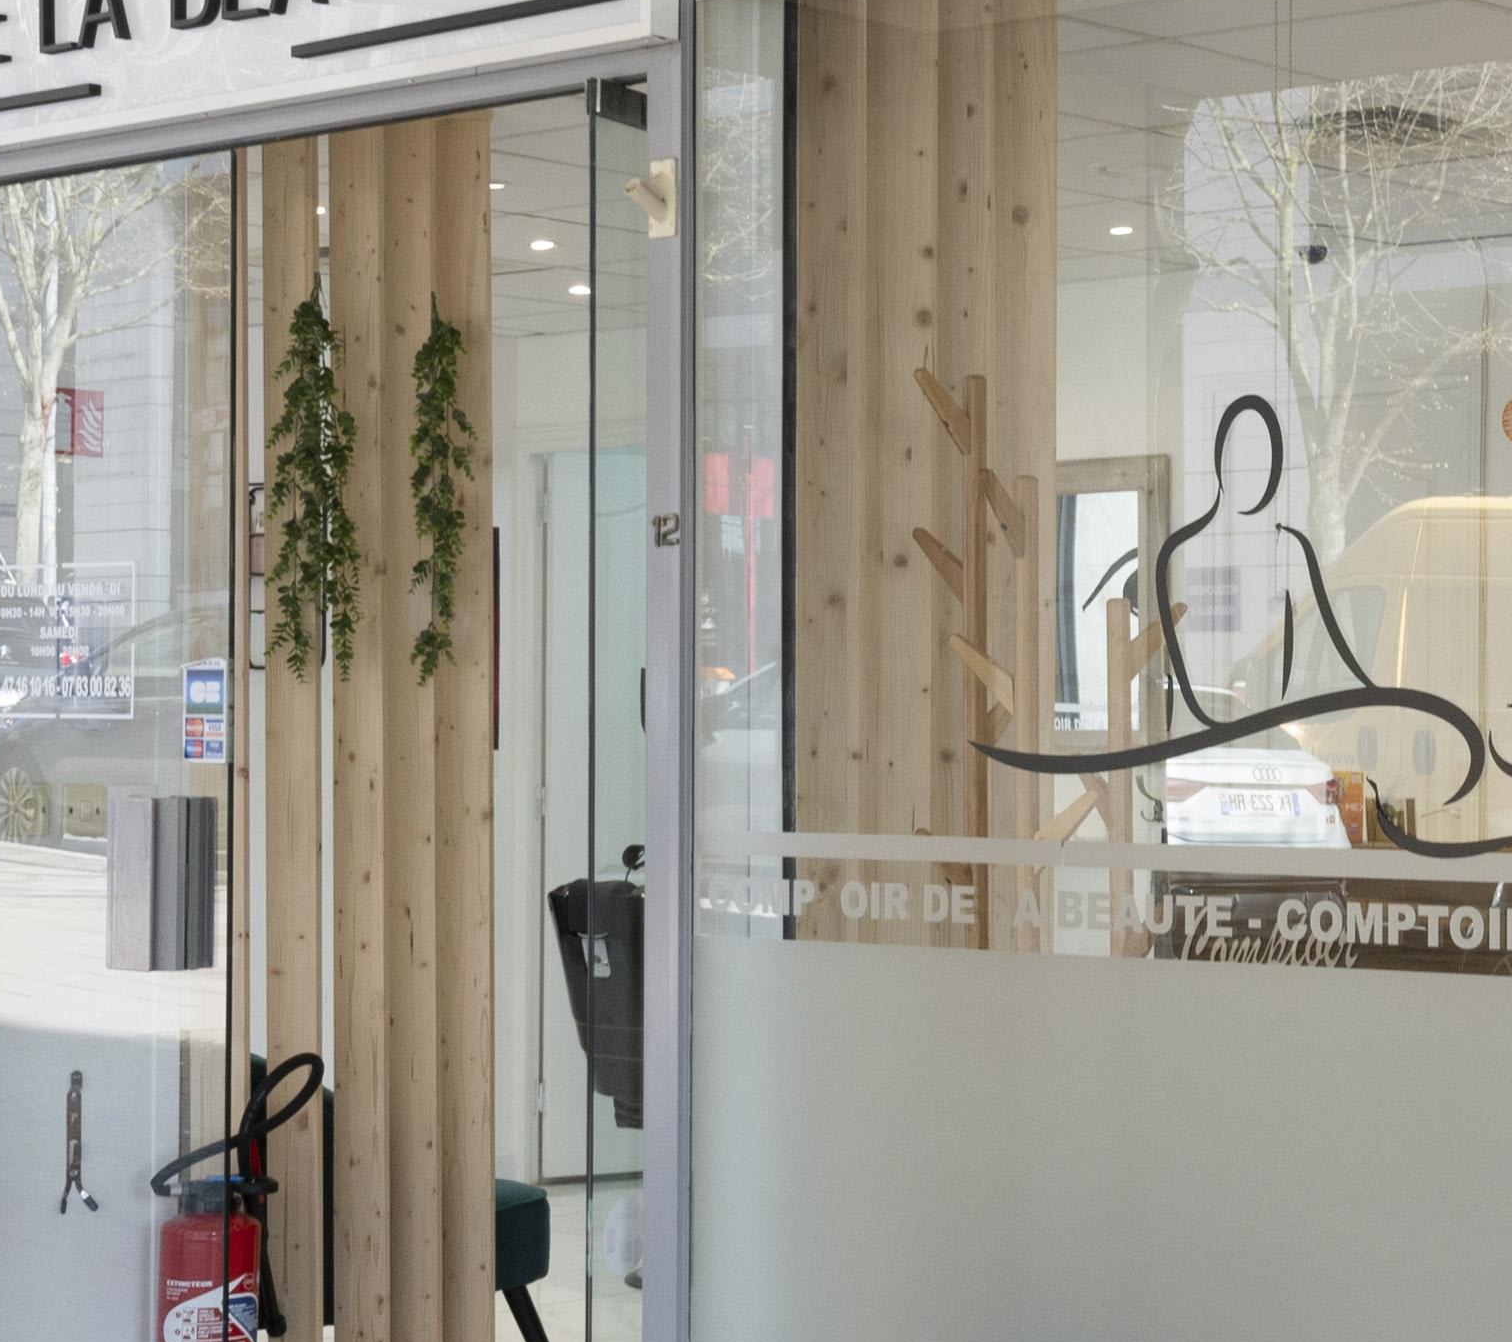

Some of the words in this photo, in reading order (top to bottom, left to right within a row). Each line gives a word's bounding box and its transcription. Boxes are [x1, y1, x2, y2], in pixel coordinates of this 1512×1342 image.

[652, 514, 680, 547] 12
[0, 585, 14, 598] DU
[17, 585, 49, 597] LUND
[68, 583, 121, 596] VENDRDI
[39, 626, 78, 639] SAMEDI
[62, 676, 73, 696] 07
[75, 676, 88, 697] 83
[90, 676, 102, 697] 00
[104, 676, 117, 697] 82
[119, 676, 132, 697] 36
[704, 875, 909, 920] COMPOIR
[924, 883, 976, 924] DE
[1058, 890, 1233, 938] BEAUTE
